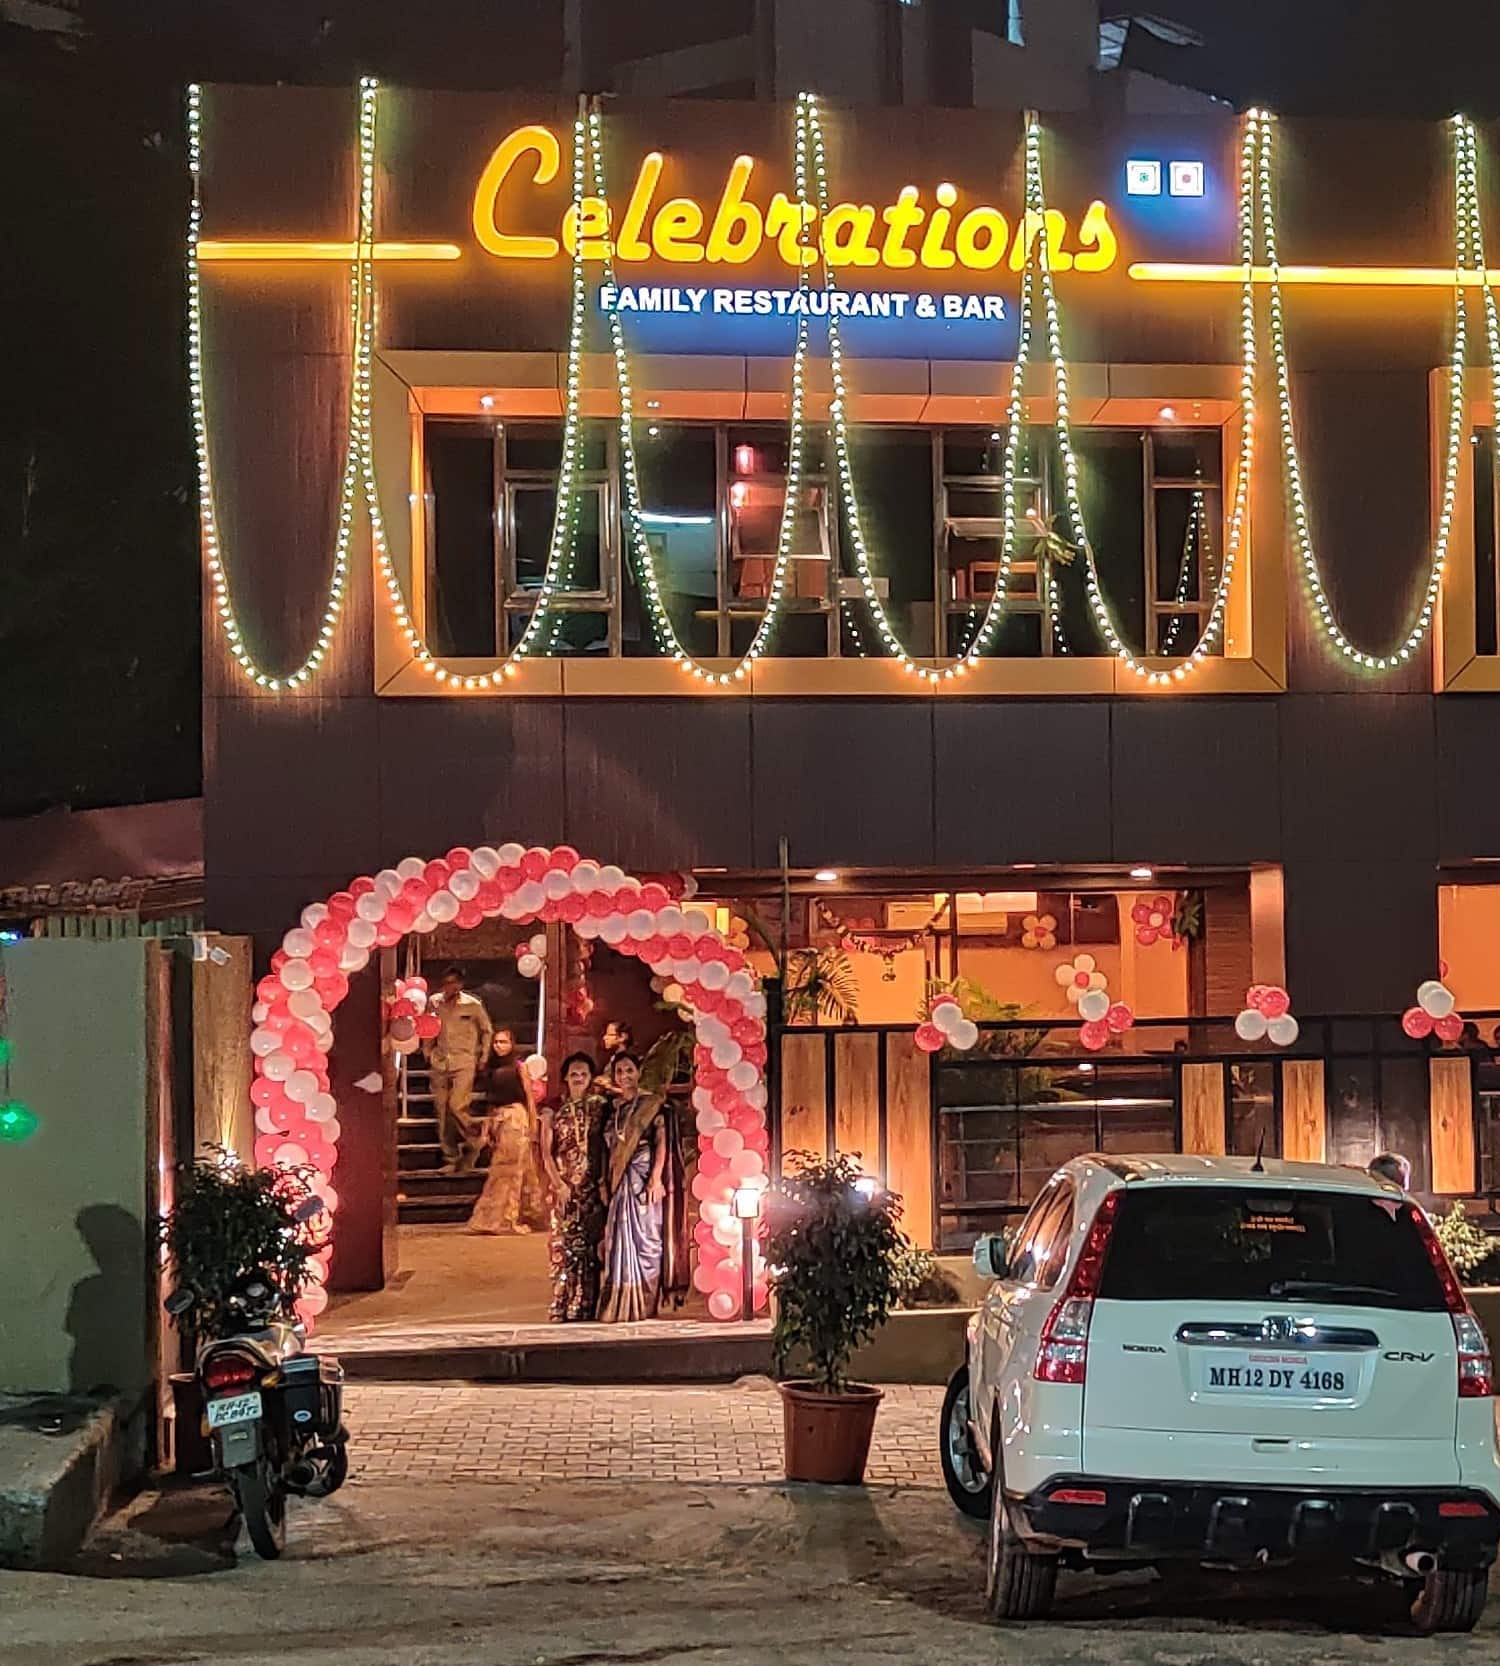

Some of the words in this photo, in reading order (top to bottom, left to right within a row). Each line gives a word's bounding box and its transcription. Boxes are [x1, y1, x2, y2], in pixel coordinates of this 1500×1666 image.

[472, 125, 1118, 273] Celebrations
[600, 286, 708, 313] FAMILY
[713, 288, 910, 318] RESTAURANT
[915, 293, 938, 318] &
[943, 295, 1006, 320] BAR
[1122, 1343, 1168, 1354] HONDA
[1268, 1369, 1295, 1389] DY
[1299, 1370, 1345, 1391] 4168
